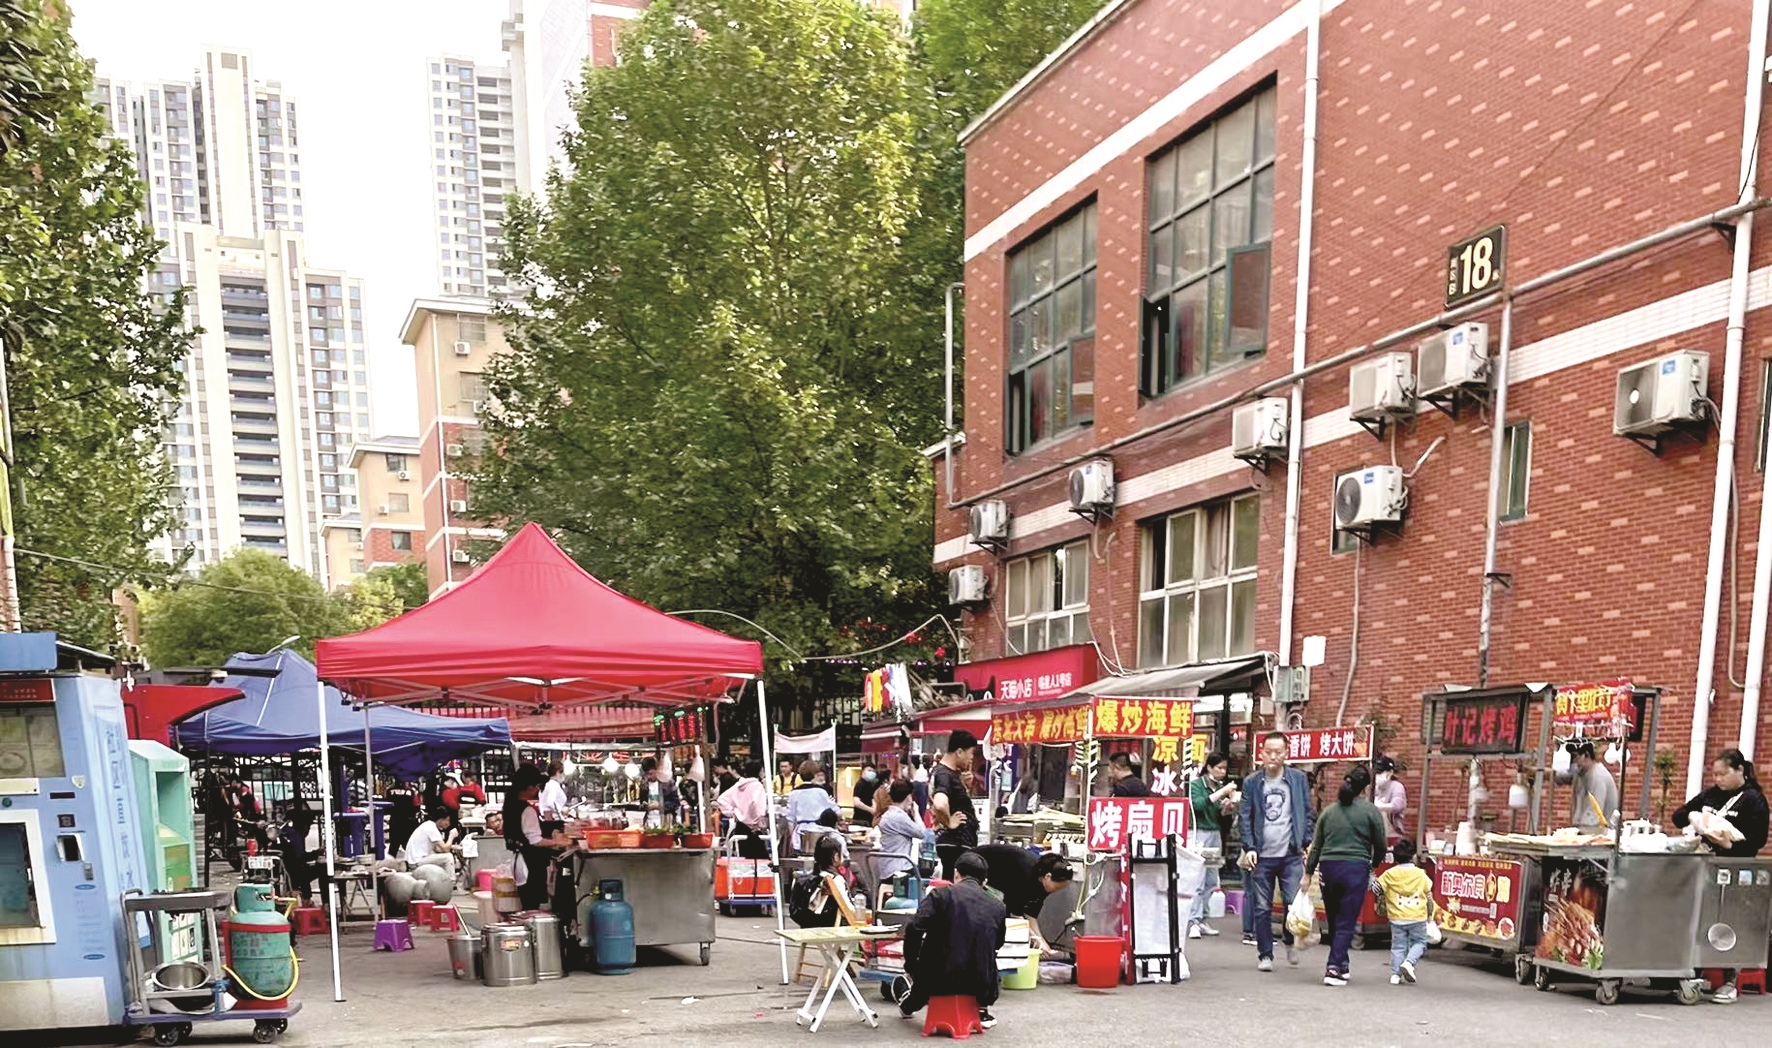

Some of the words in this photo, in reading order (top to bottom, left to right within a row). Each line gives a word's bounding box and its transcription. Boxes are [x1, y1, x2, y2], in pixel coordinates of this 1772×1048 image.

[1460, 237, 1493, 294] 18
[1096, 699, 1191, 736] 爆炒海鲜
[1320, 731, 1354, 756] 烤大饼
[1091, 800, 1185, 848] 烤扇贝
